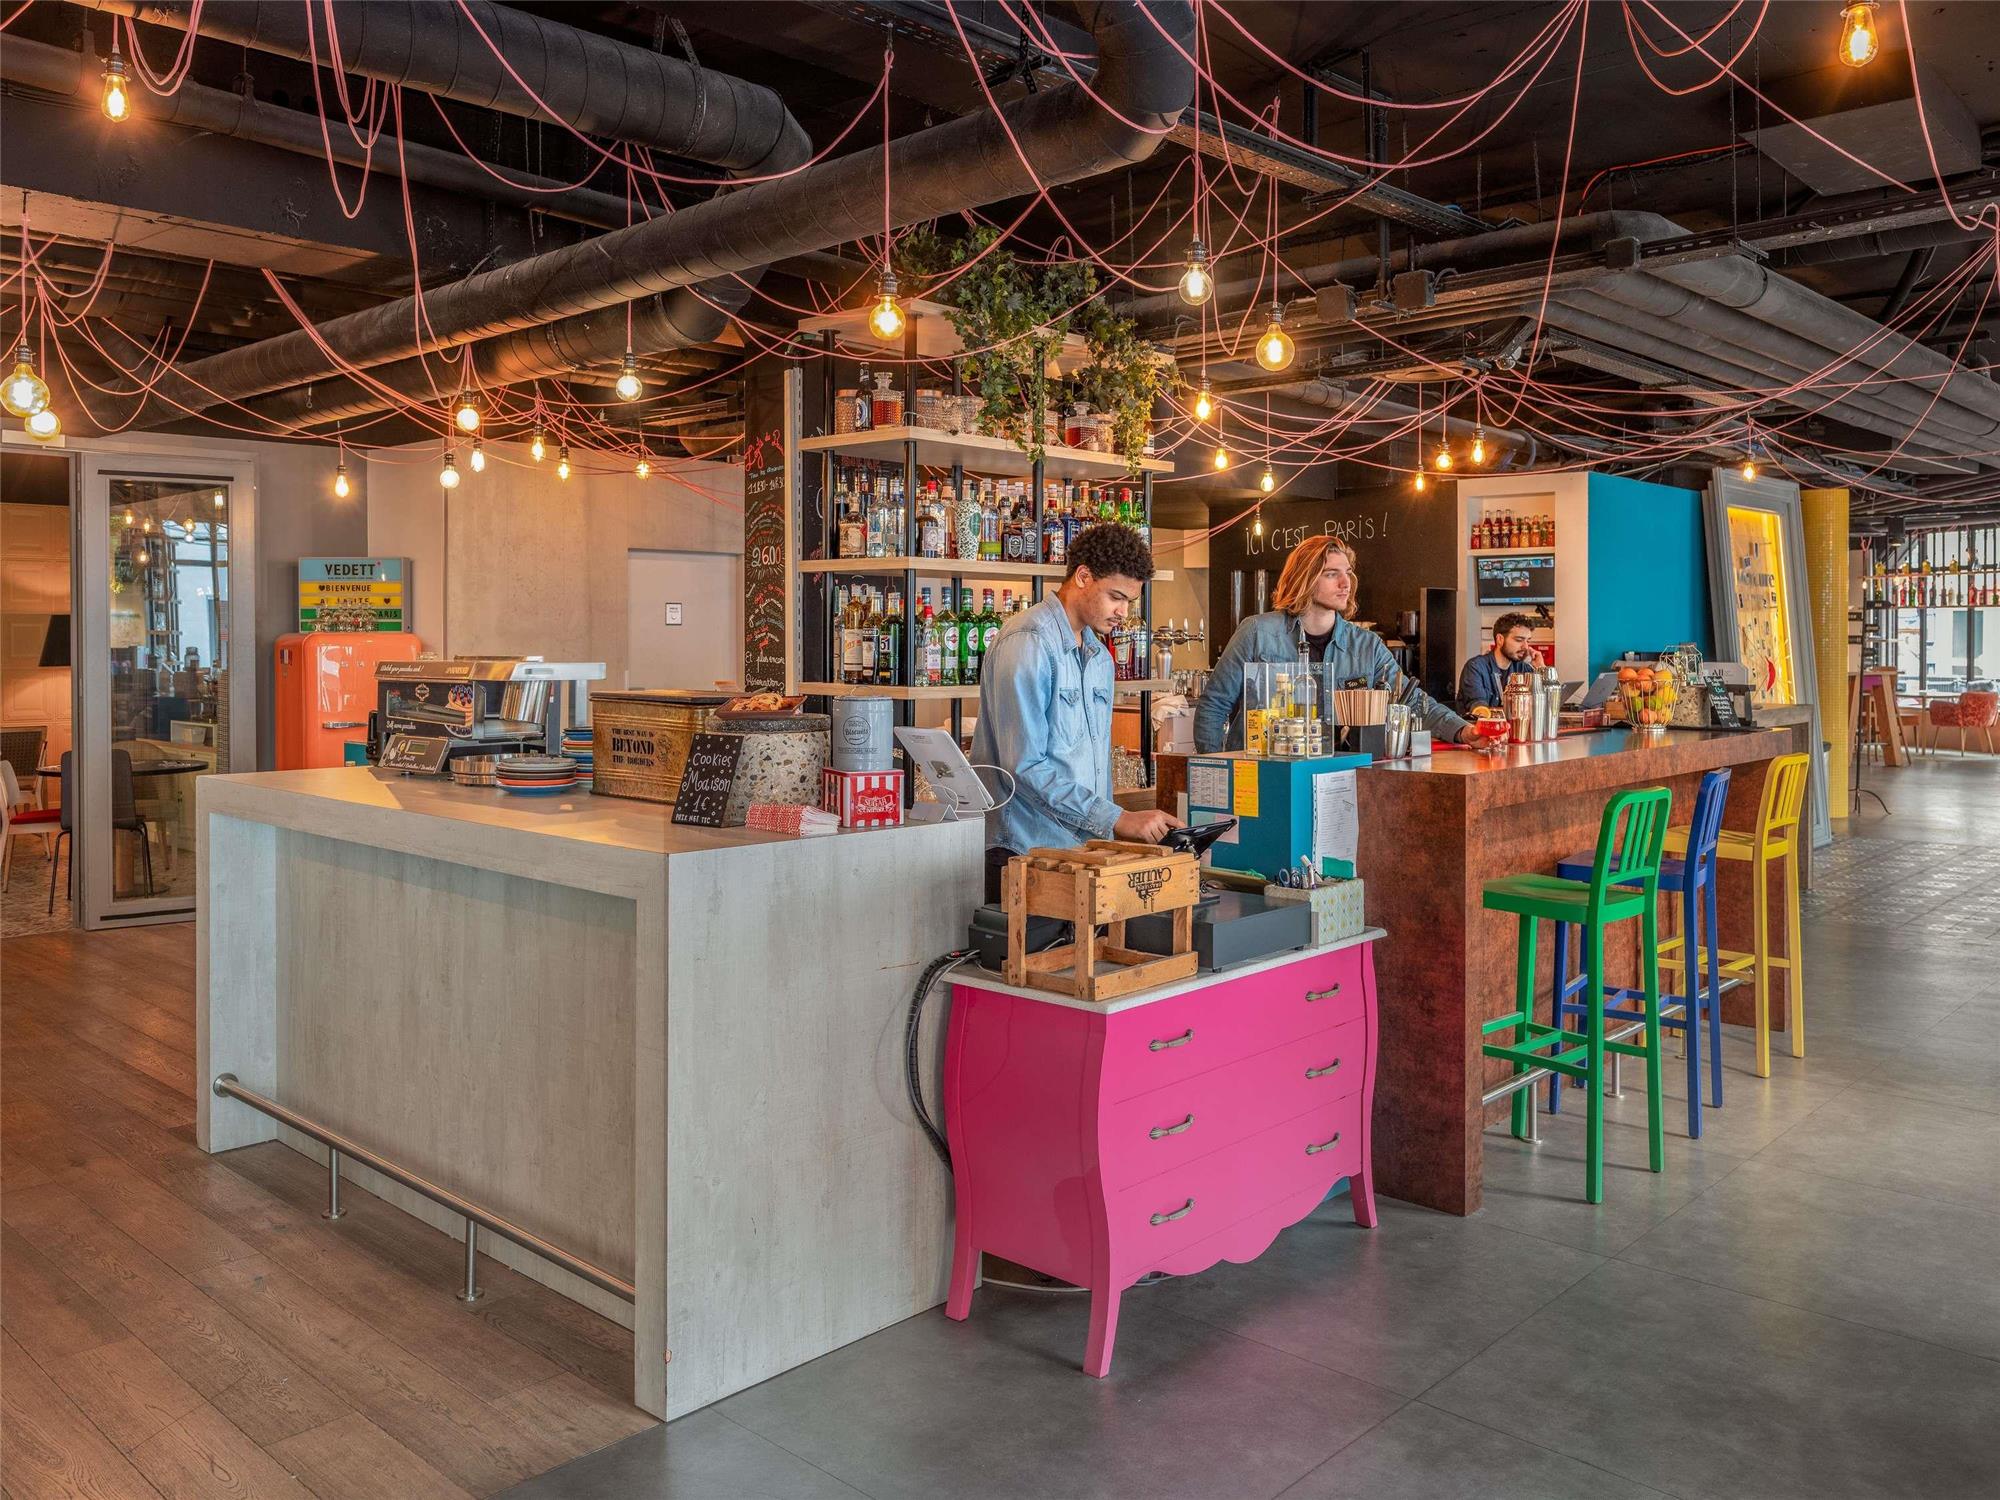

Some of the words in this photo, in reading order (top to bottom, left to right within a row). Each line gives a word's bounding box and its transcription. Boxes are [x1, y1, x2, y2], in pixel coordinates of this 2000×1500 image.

[1271, 525, 1310, 552] C'EST
[325, 564, 376, 576] VEDETT
[326, 584, 372, 592] BIENVENUE
[880, 635, 891, 650] 51
[612, 737, 655, 756] BEYOND
[612, 755, 624, 764] THE
[627, 756, 655, 767] BORDERS
[692, 752, 733, 767] Cookies
[682, 770, 731, 793] Maison
[864, 797, 887, 807] SUGAR
[1128, 867, 1172, 888] CAULIER
